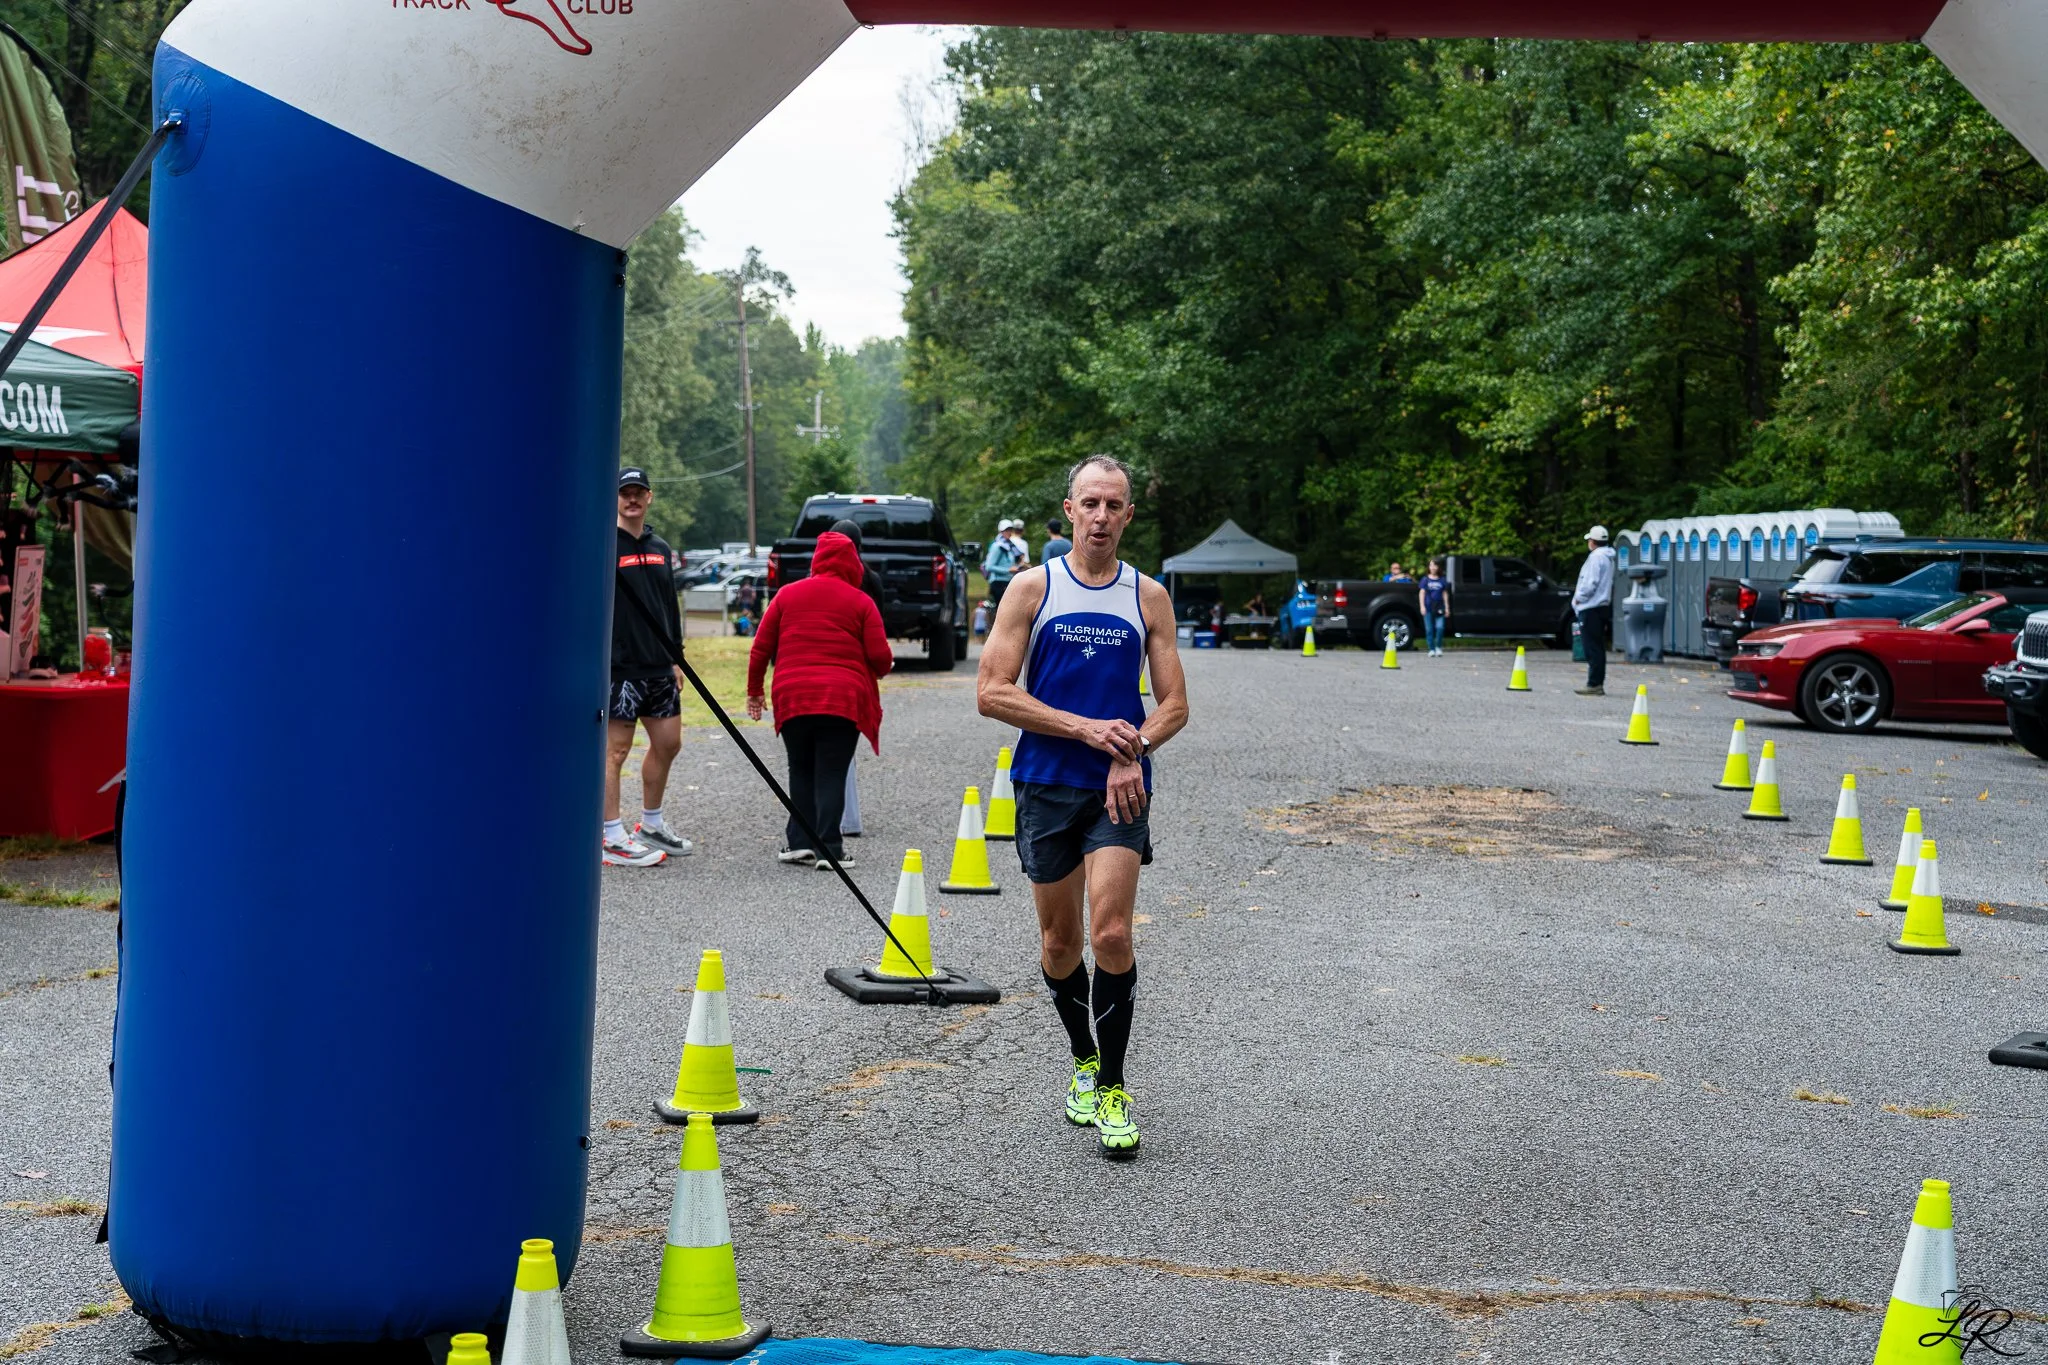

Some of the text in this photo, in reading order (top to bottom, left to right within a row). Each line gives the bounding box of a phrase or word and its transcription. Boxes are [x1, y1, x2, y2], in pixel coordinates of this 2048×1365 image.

[566, 0, 634, 14] CLUB
[1054, 623, 1128, 638] PILGRIMAGE
[1060, 634, 1121, 645] TRACK CLUB
